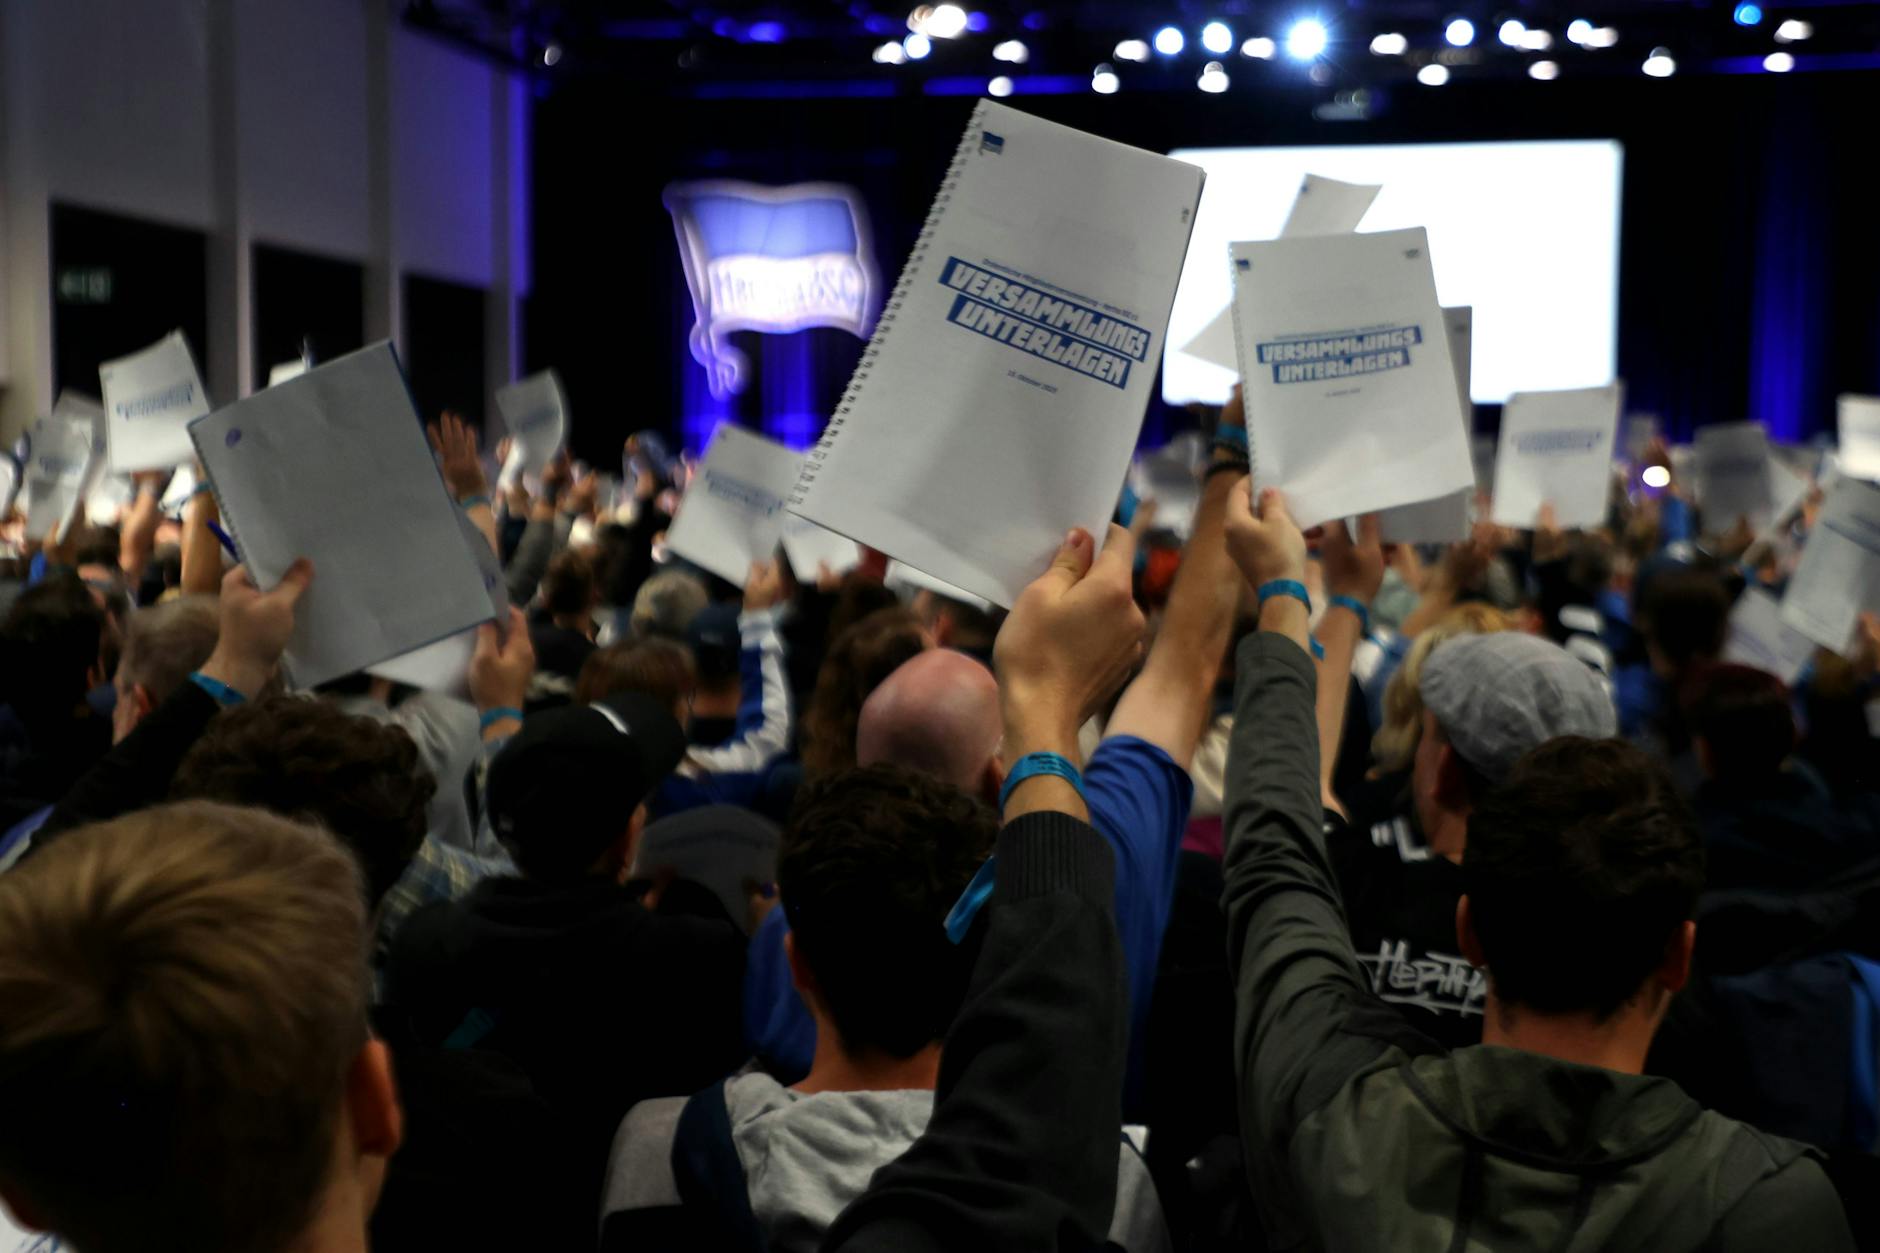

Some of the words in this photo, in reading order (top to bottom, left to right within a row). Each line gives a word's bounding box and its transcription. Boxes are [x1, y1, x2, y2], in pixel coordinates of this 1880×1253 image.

[948, 262, 1147, 359] VERSAMMLUNGS
[955, 301, 1128, 385] UNTERLAGEN
[1260, 327, 1417, 363] VERSAMMLUNGS
[1277, 350, 1406, 382] UNTERLAGEN
